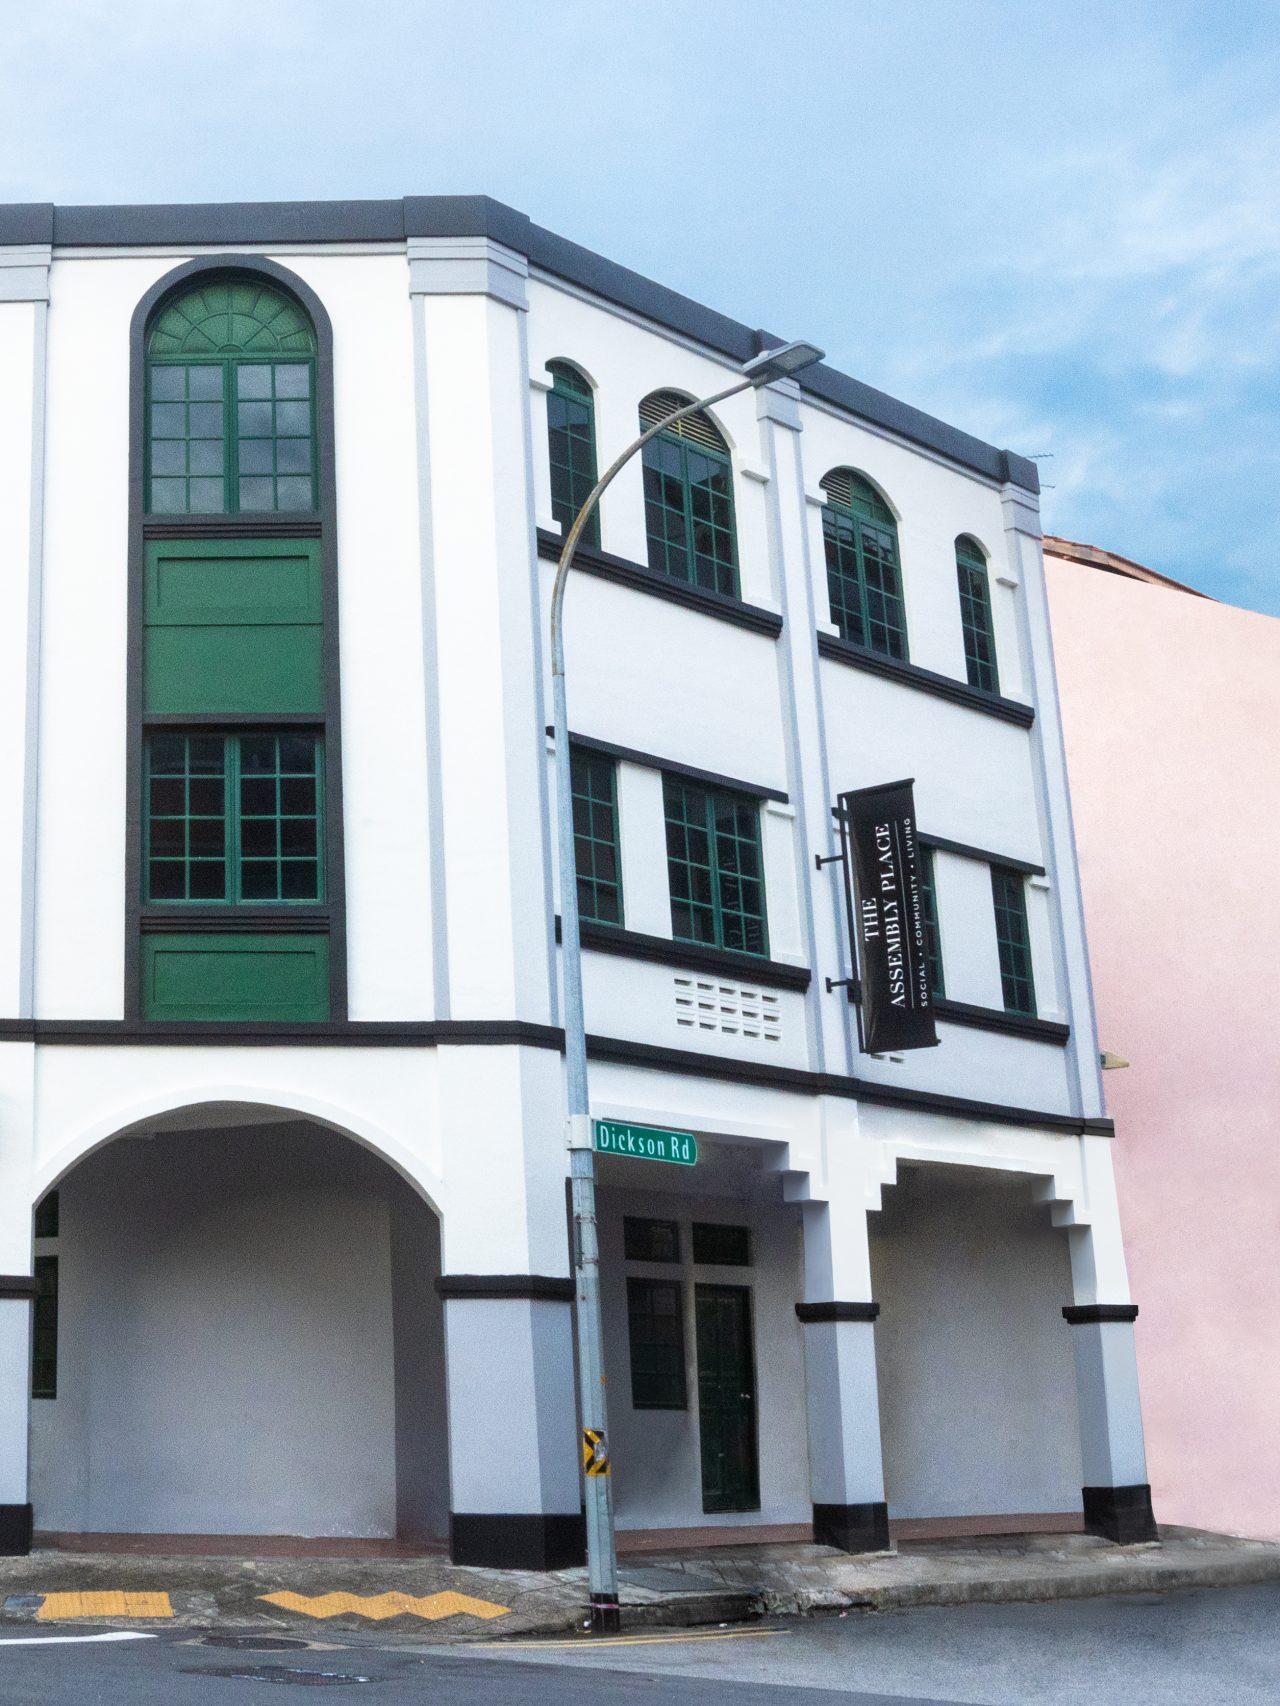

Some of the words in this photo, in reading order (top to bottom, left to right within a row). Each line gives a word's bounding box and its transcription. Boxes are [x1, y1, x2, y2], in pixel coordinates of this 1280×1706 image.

[875, 823, 896, 895] PLACE
[903, 818, 914, 858] LIVING
[862, 897, 879, 942] THE
[912, 875, 923, 946] COMMUNITY
[882, 899, 905, 1009] ASSEMBLY
[920, 962, 928, 1007] SOCIAL
[600, 1125, 665, 1156] Dickson
[671, 1136, 690, 1160] Rd
